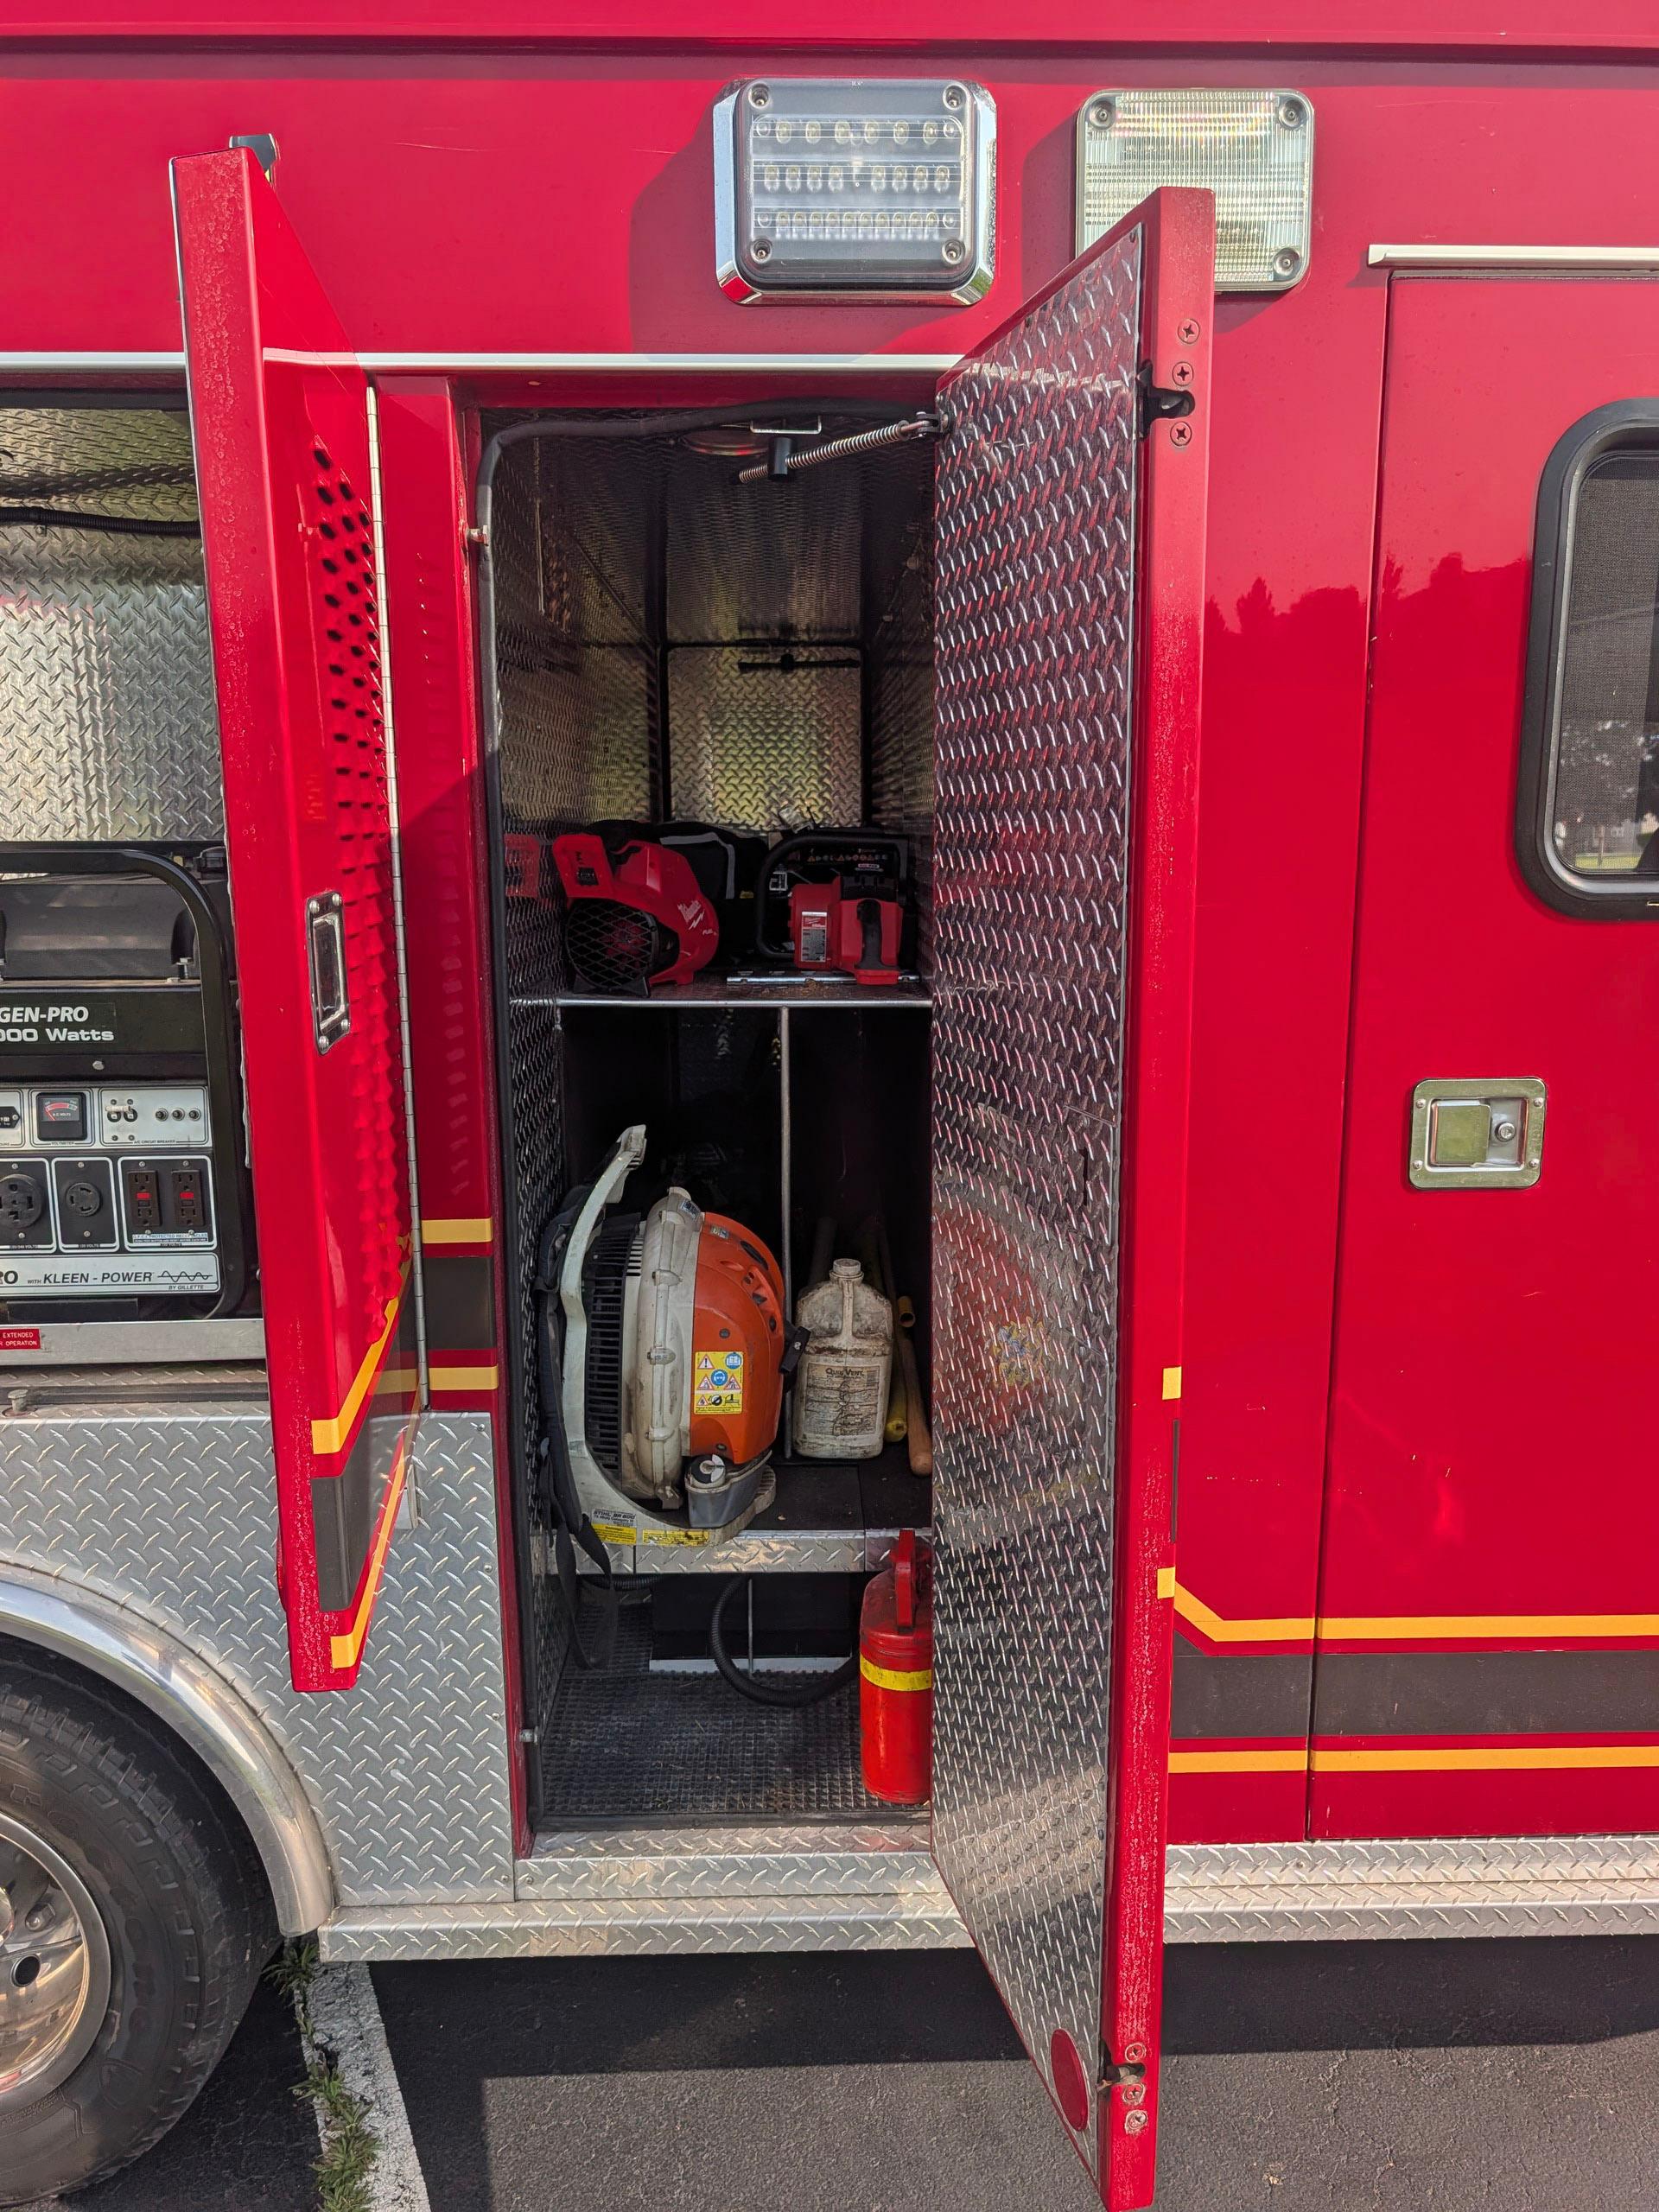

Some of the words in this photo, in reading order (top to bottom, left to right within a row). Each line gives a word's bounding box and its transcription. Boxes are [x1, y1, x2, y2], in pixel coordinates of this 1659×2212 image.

[0, 1006, 89, 1023] GEN-PRO
[45, 1028, 114, 1042] Watts
[0, 1270, 18, 1284] O
[43, 1273, 90, 1284] KLEEN
[101, 1272, 152, 1283] POWER
